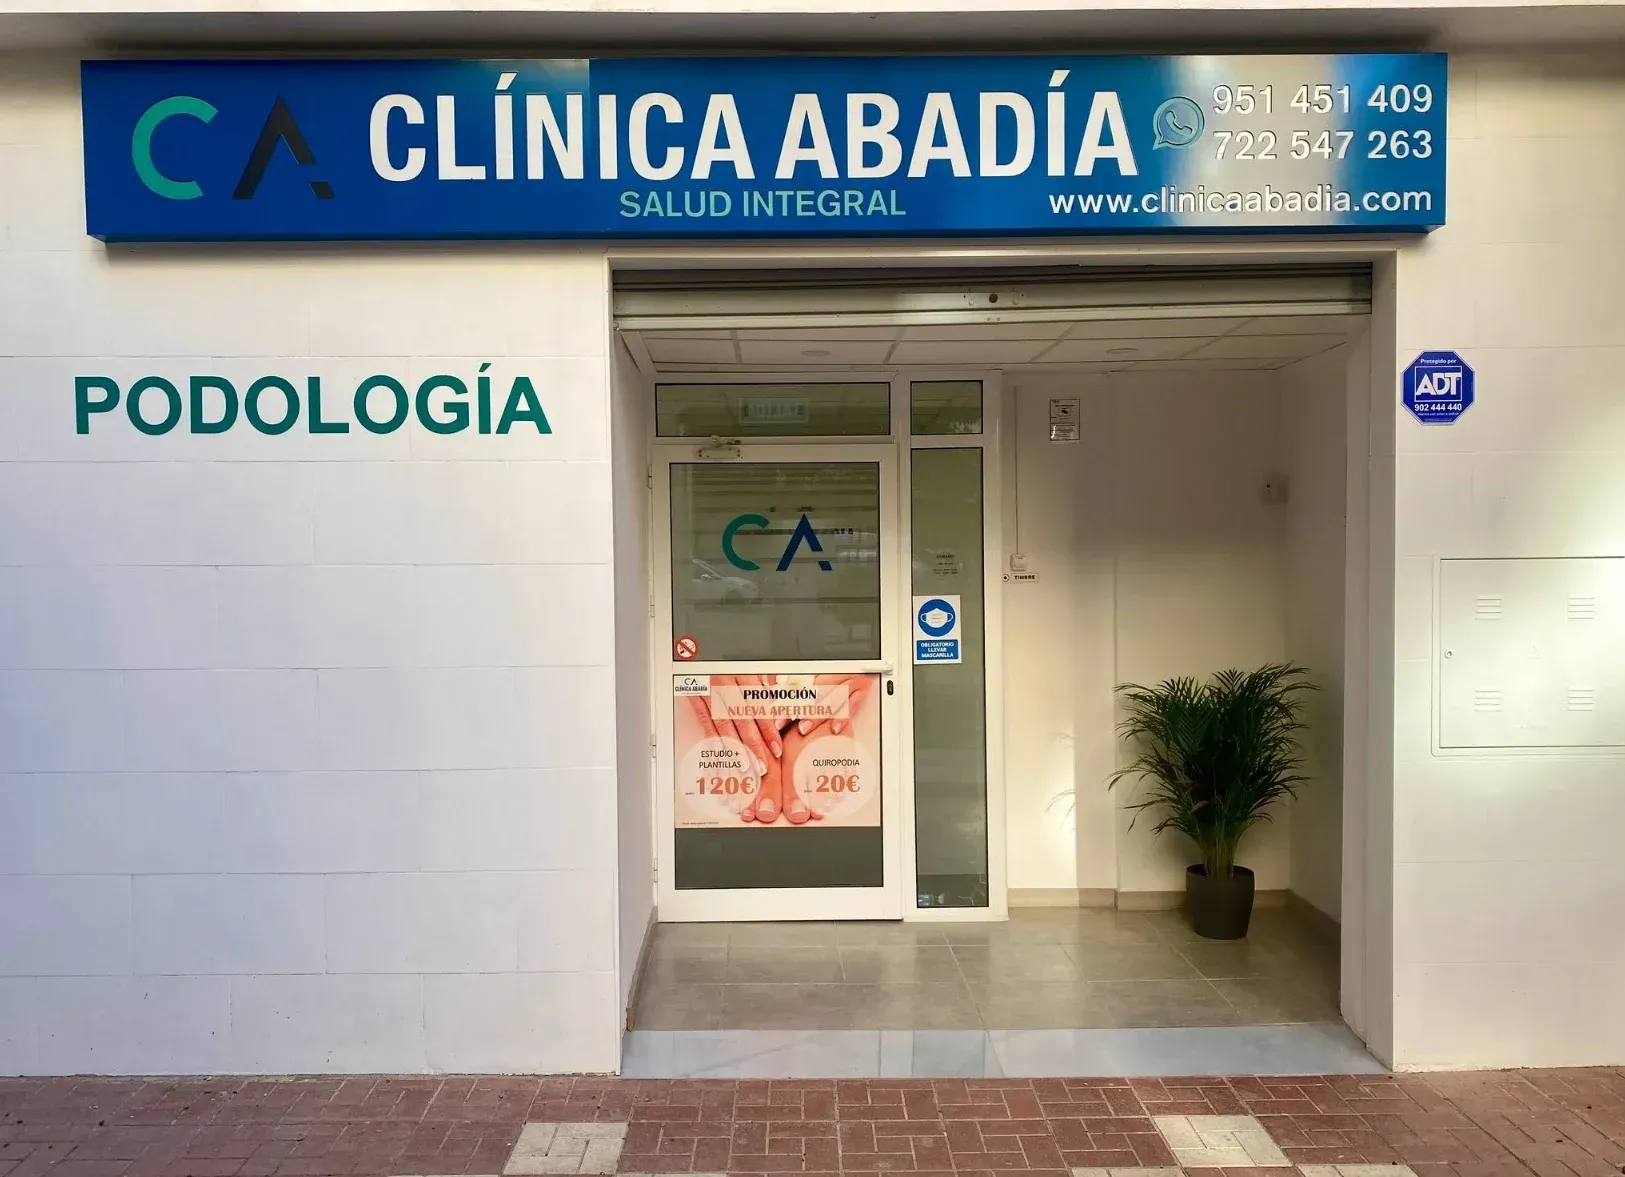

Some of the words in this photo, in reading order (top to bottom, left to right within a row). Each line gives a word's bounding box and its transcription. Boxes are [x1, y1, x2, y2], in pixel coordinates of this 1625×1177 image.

[1212, 84, 1274, 115] 951
[1290, 84, 1351, 114] 451
[1366, 83, 1433, 114] 409
[369, 71, 756, 182] CLÍNICA
[774, 69, 1139, 179] ABADÍA
[1213, 130, 1278, 160] 722
[1290, 130, 1354, 160] 547
[1367, 129, 1433, 159] 263
[619, 190, 732, 218] SALUD
[743, 189, 907, 217] INTEGRAL
[1048, 184, 1432, 214] www.clinicaabadia.com
[1416, 372, 1462, 396] ADT
[74, 363, 553, 436] PODOLOGÍA
[1414, 403, 1430, 412] 902
[1430, 403, 1446, 411] 444
[1447, 403, 1462, 411] 440
[722, 513, 833, 572] CA
[743, 686, 817, 701] PROMOCIÓN
[728, 705, 767, 717] NUEVA
[769, 704, 834, 717] APERTURA
[698, 760, 742, 769] PLANTILLAS
[700, 750, 734, 759] ESTUDIO
[812, 758, 861, 768] QUIROPODIA
[696, 776, 755, 796] 120€
[815, 774, 861, 794] 20€
